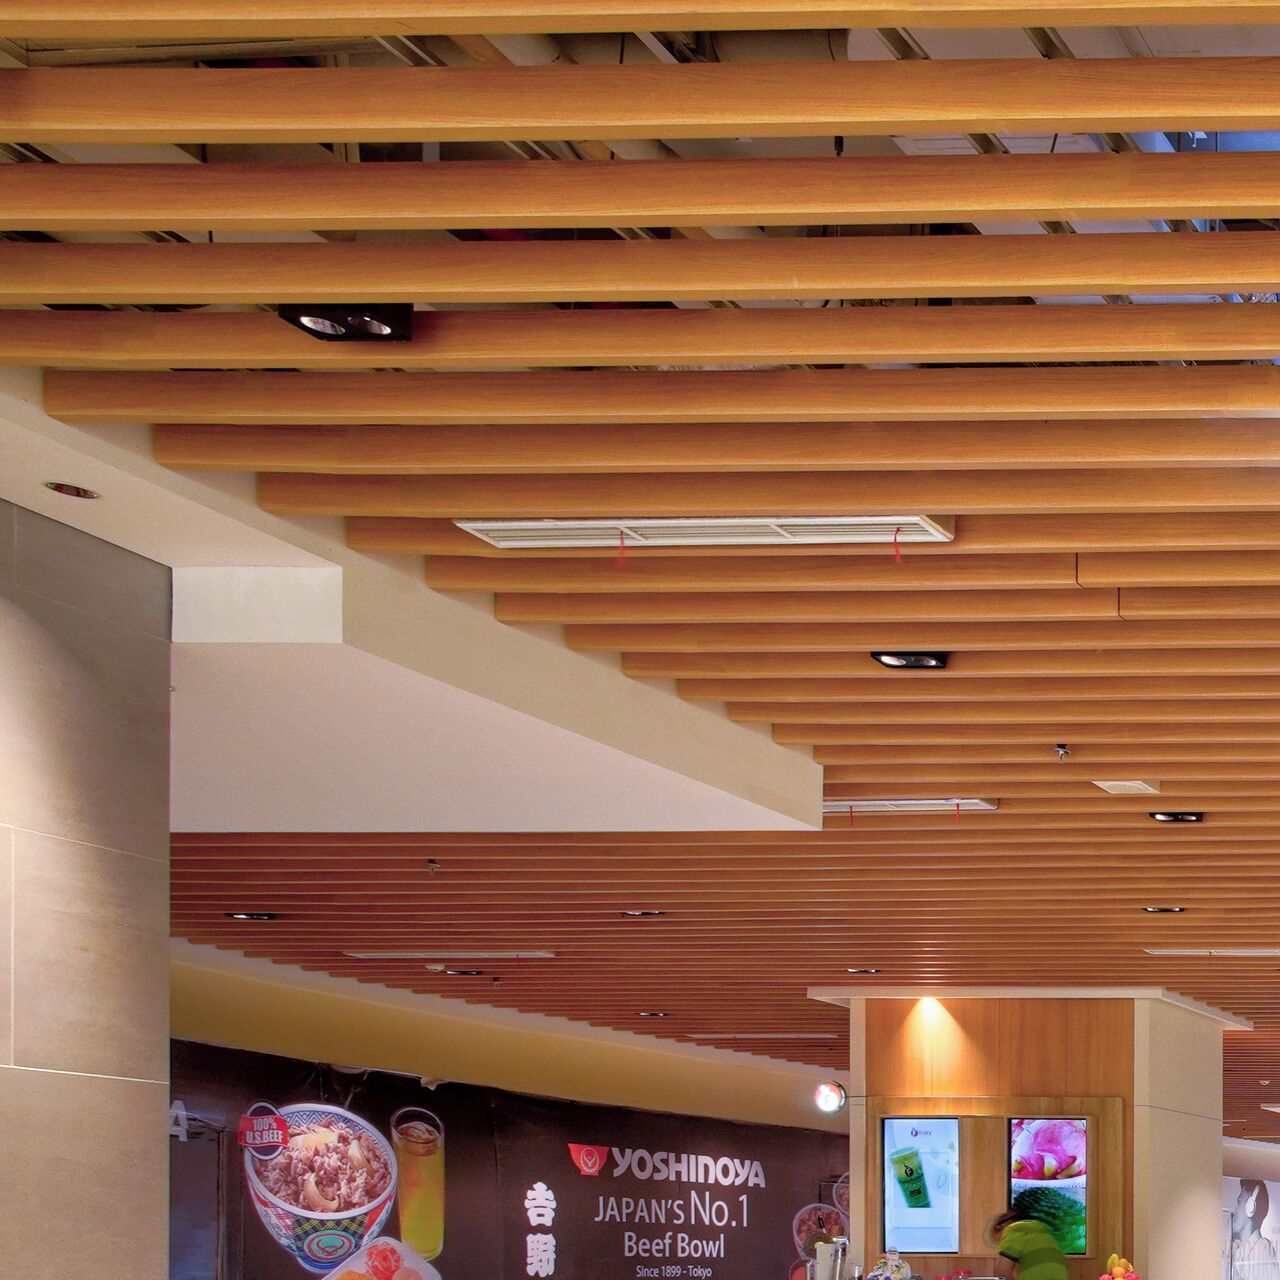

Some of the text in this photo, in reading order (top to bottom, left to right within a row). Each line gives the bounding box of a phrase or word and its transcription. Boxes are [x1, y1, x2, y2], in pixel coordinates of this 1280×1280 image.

[253, 1117, 277, 1130] 100%
[612, 1147, 766, 1188] YOSHINOYA
[690, 1190, 748, 1227] No.1
[624, 1232, 725, 1258] Beef Bowl
[636, 1265, 712, 1280] Since 1899 Tokyo
